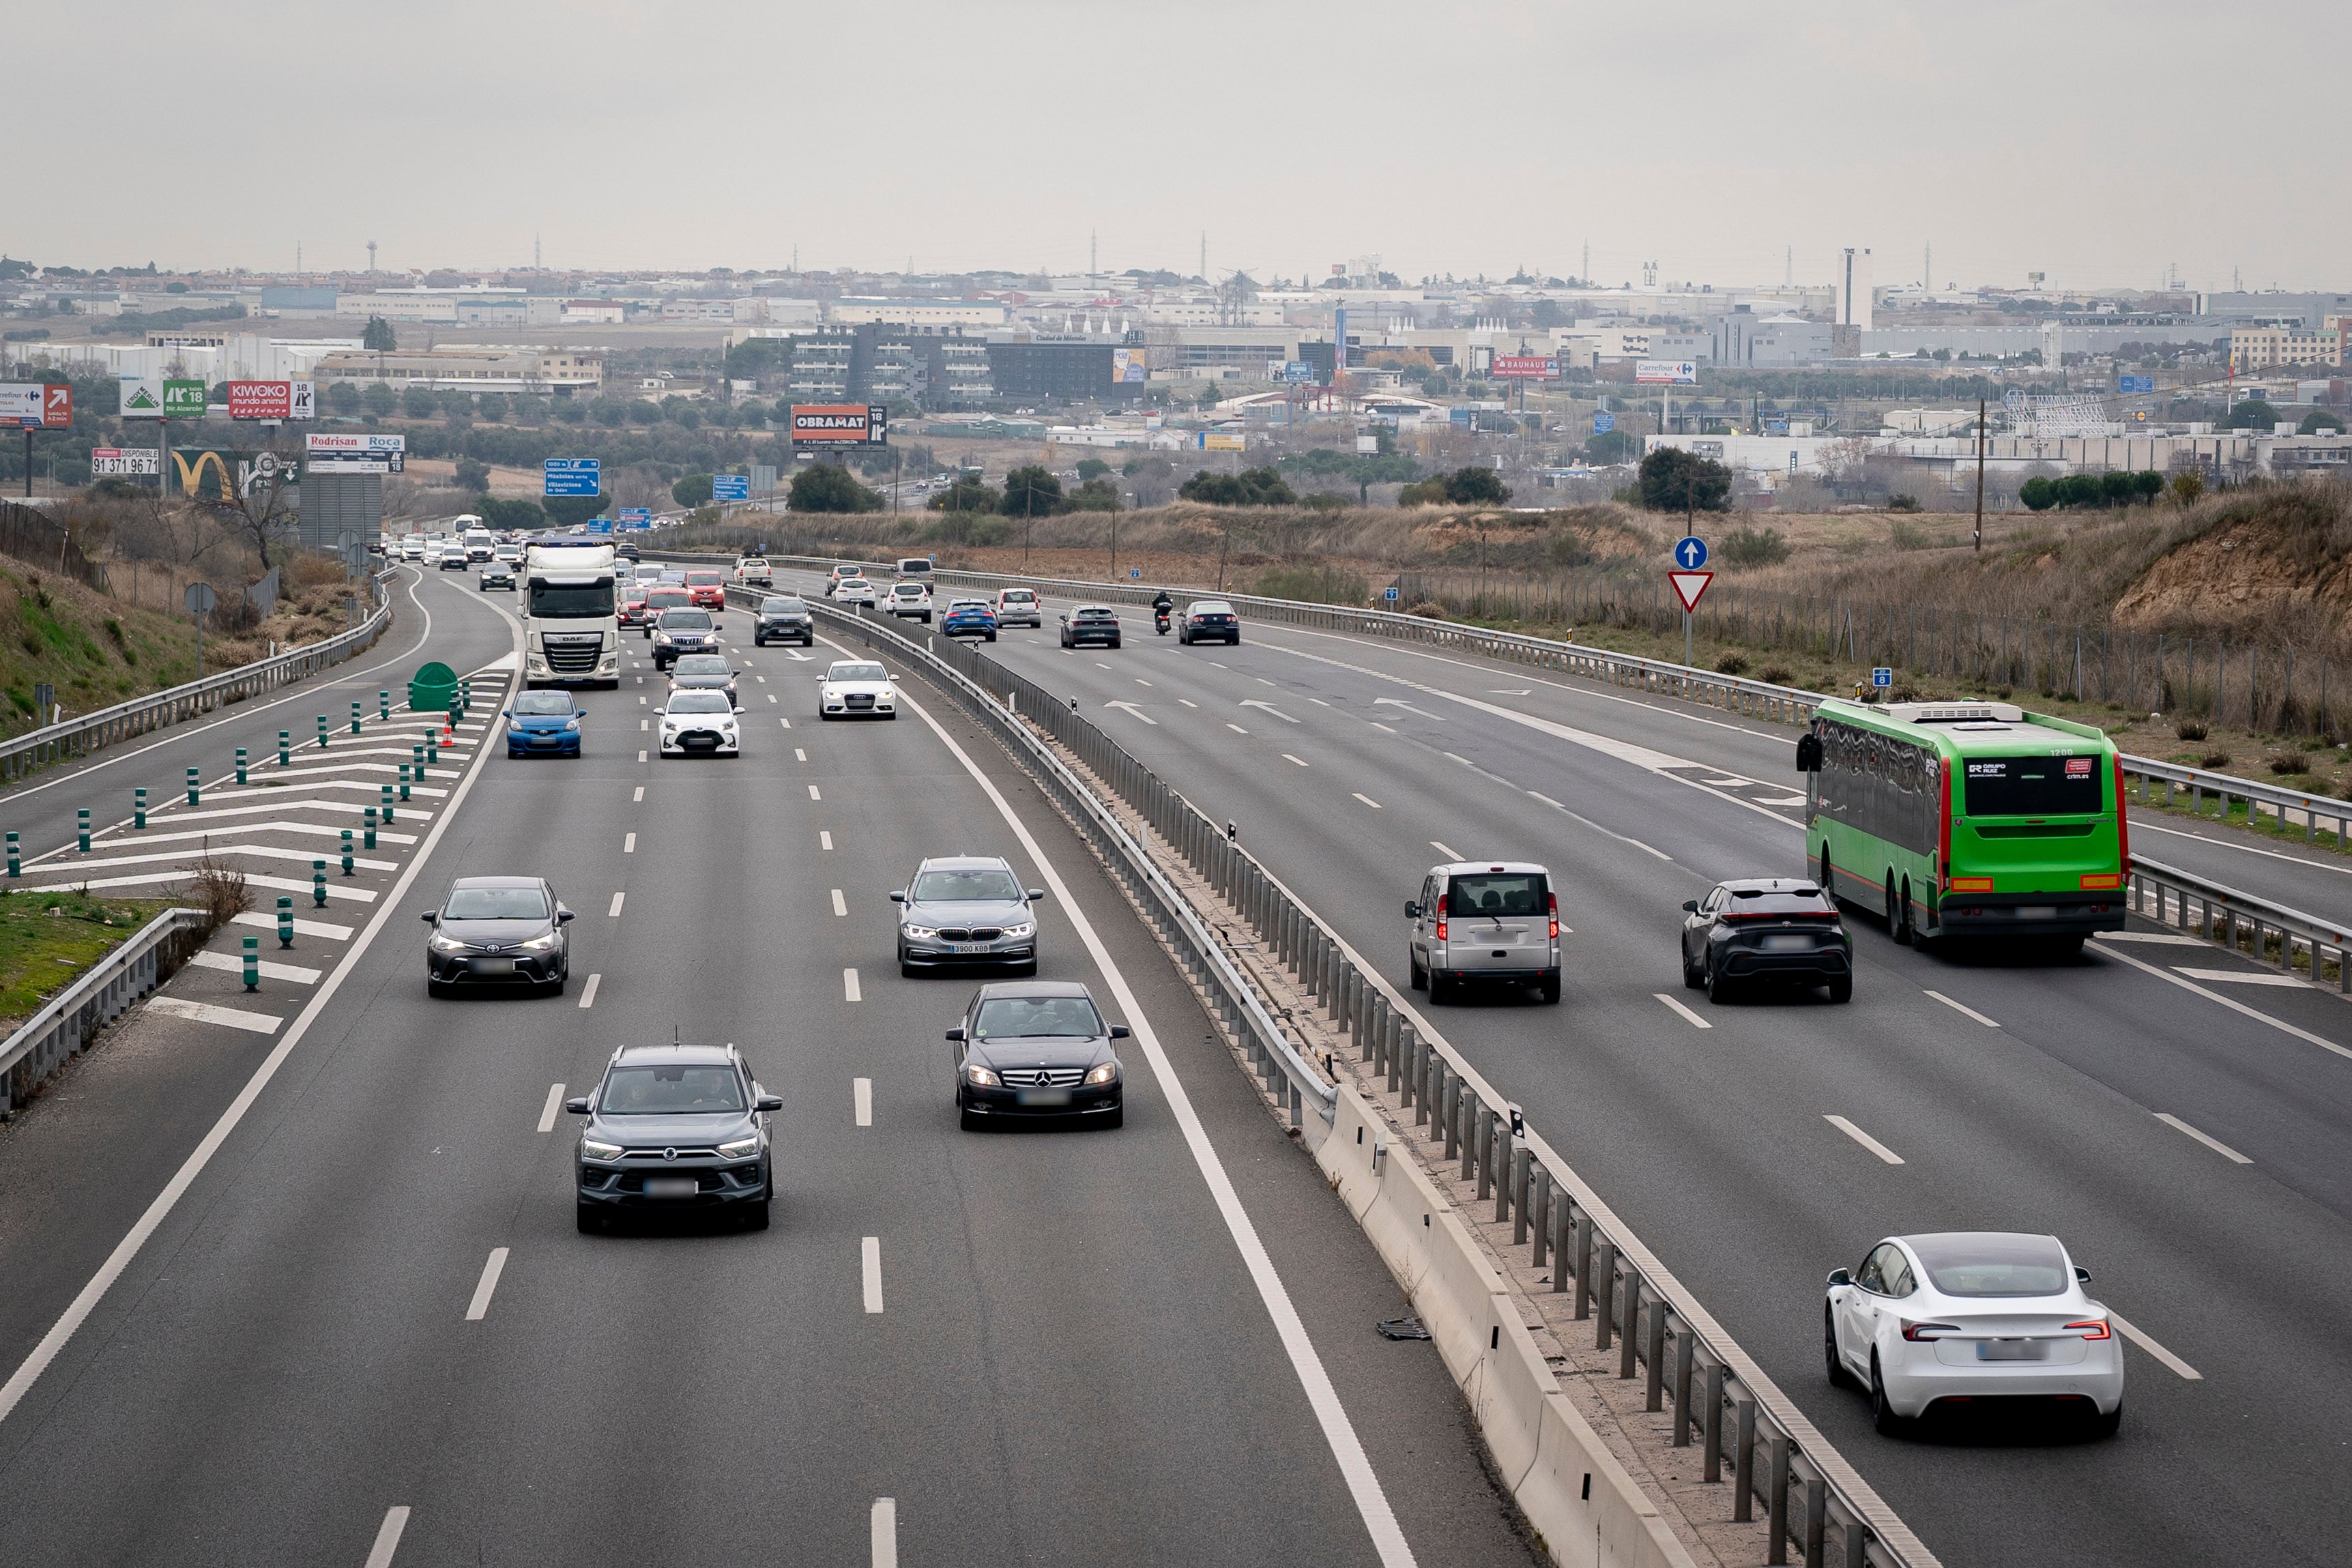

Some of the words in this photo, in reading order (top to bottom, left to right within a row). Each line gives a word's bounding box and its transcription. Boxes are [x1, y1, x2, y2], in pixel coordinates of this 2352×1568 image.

[232, 385, 287, 396] KIWOKO
[124, 390, 141, 407] LEROY
[139, 386, 160, 407] MERLIN
[189, 392, 203, 403] 18
[233, 396, 260, 405] mundo
[796, 417, 865, 428] OBRAMAT
[871, 413, 882, 421] 18
[311, 437, 358, 446] Rodrisan
[369, 437, 401, 446] Roca
[93, 459, 105, 472] 91
[109, 459, 127, 472] 371
[131, 459, 143, 473] 96
[147, 459, 158, 473] 71
[2050, 749, 2073, 757] 1200
